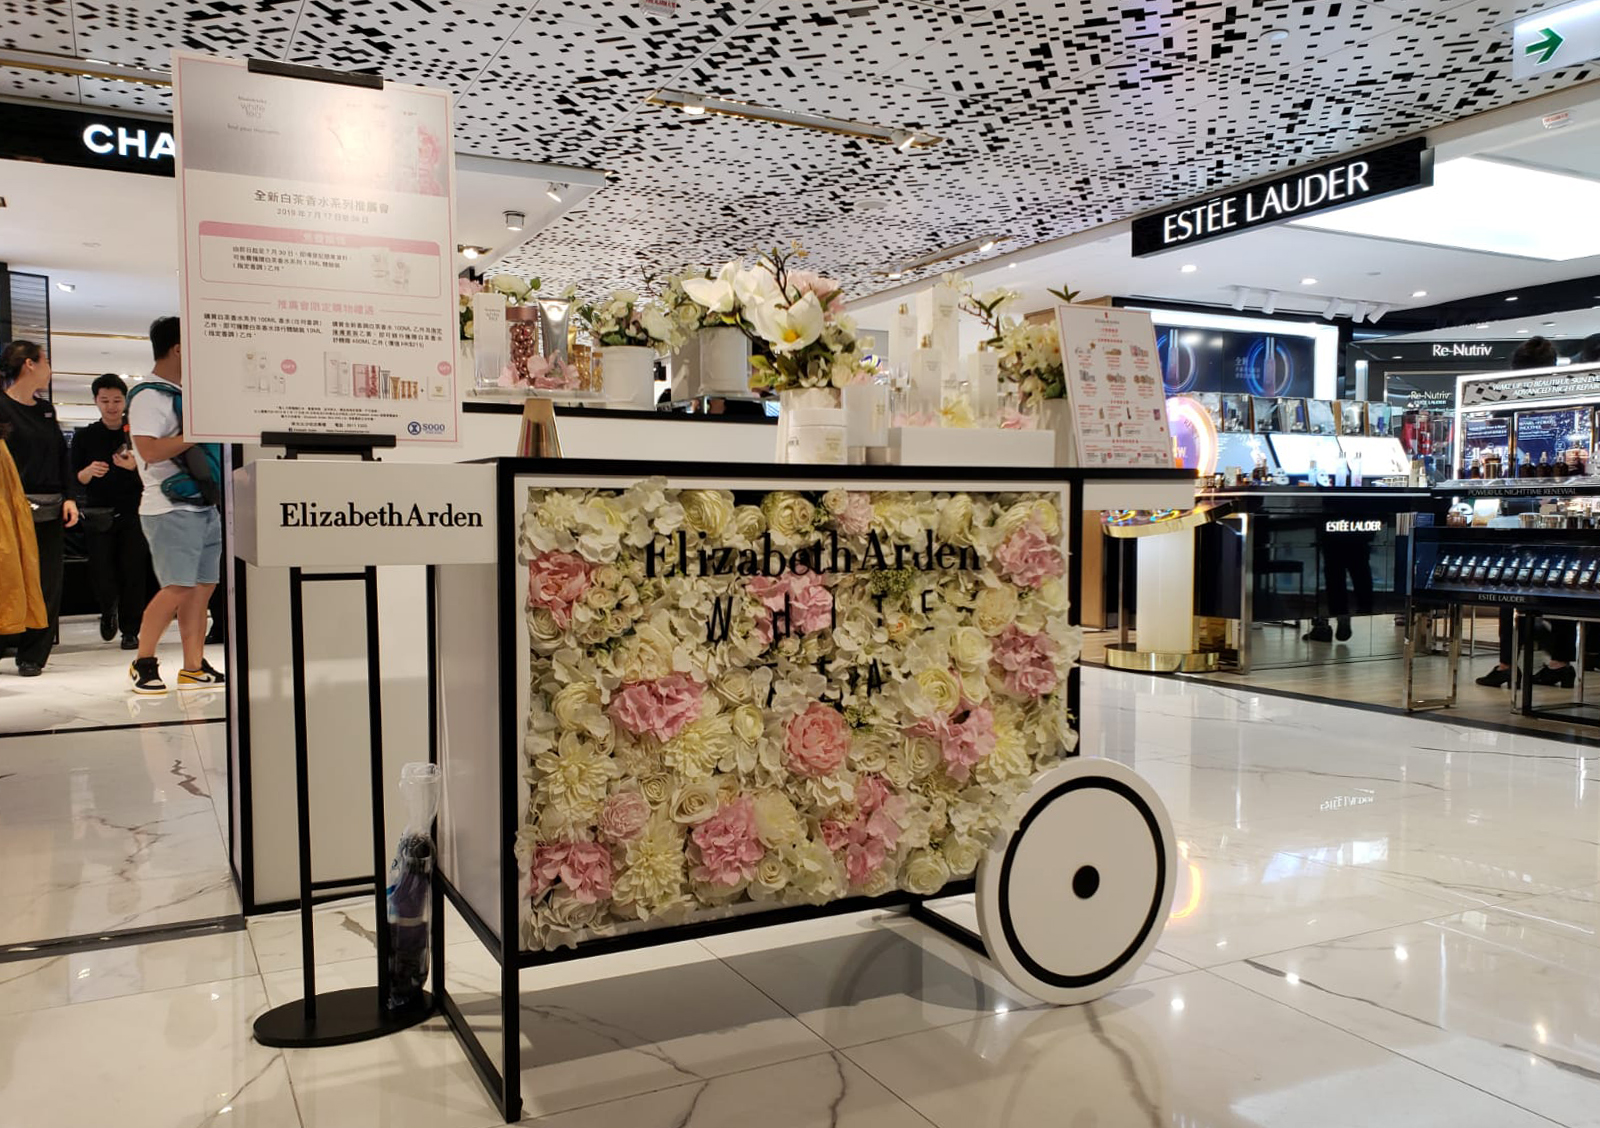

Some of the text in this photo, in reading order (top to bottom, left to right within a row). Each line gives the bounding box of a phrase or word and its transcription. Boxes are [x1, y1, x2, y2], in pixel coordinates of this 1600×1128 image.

[83, 123, 175, 160] CHA
[1163, 160, 1370, 244] ESTÉE LAUDER
[1432, 343, 1493, 357] Re-Nutriv
[1411, 390, 1451, 400] Re-Nutriv
[1504, 488, 1542, 496] NIGHTTIME
[1543, 487, 1576, 495] RENEWAL
[280, 502, 484, 527] ElizabethArden
[1326, 519, 1381, 532] ESTÉE LAUDER
[1498, 595, 1525, 603] LAUDER
